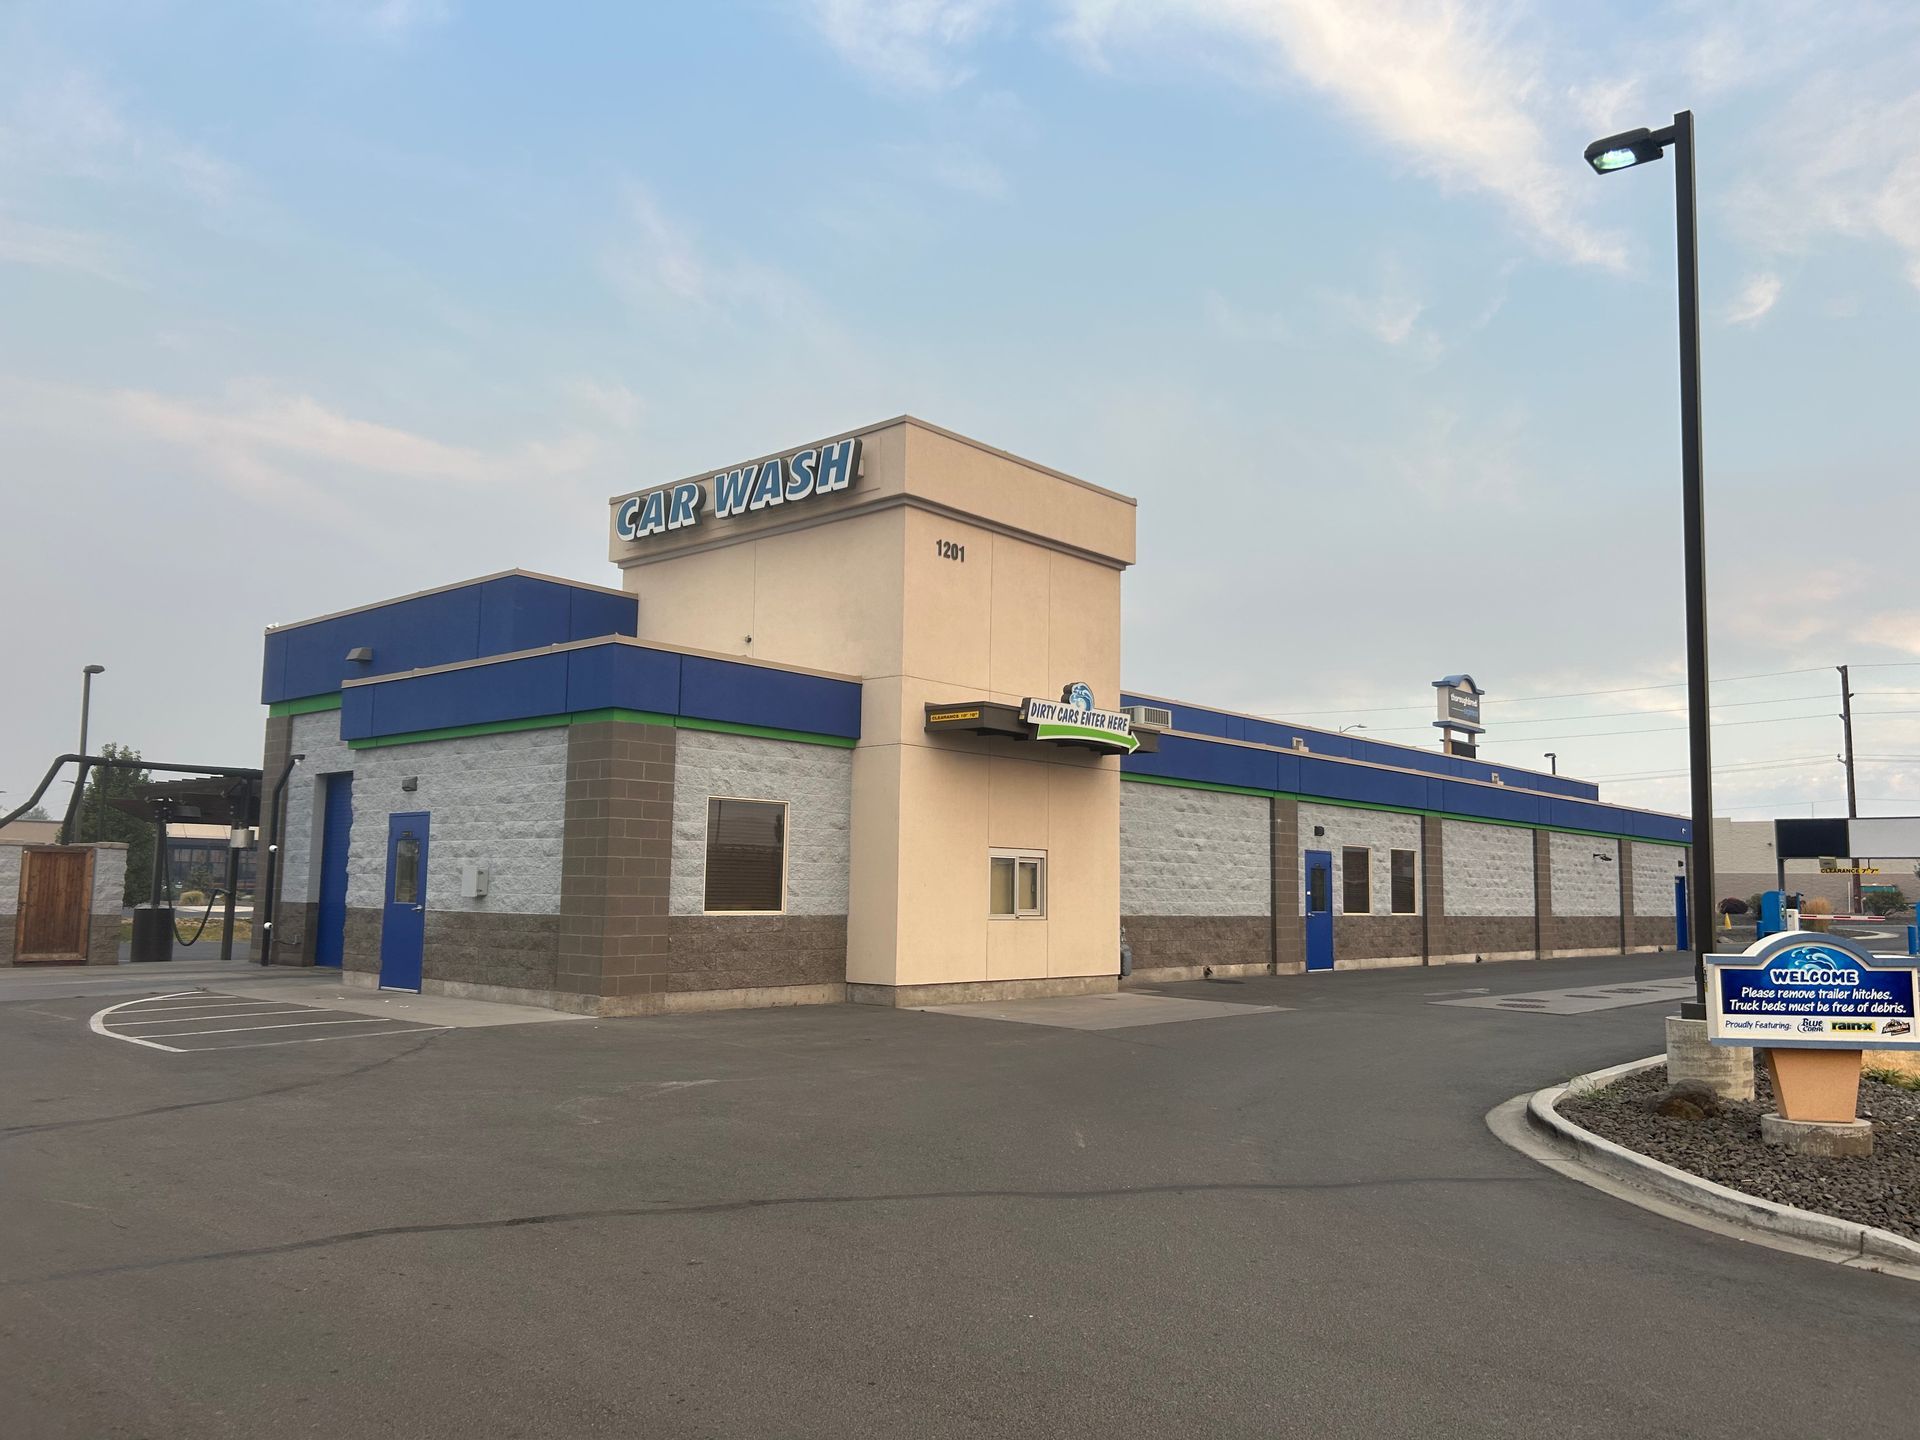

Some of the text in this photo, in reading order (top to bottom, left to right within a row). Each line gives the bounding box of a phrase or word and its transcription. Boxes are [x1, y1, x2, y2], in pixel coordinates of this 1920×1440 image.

[616, 438, 857, 541] CAR WASH
[936, 539, 965, 563] 1201
[1030, 702, 1128, 731] DIRTY CARS ENTER HERE
[1770, 969, 1859, 985] WELCOME
[1741, 986, 1893, 1000] Please remove trailer hitches.
[1729, 999, 1907, 1014] Truck beds must be free of debris.
[1725, 1020, 1792, 1030] Proudly Featuring:
